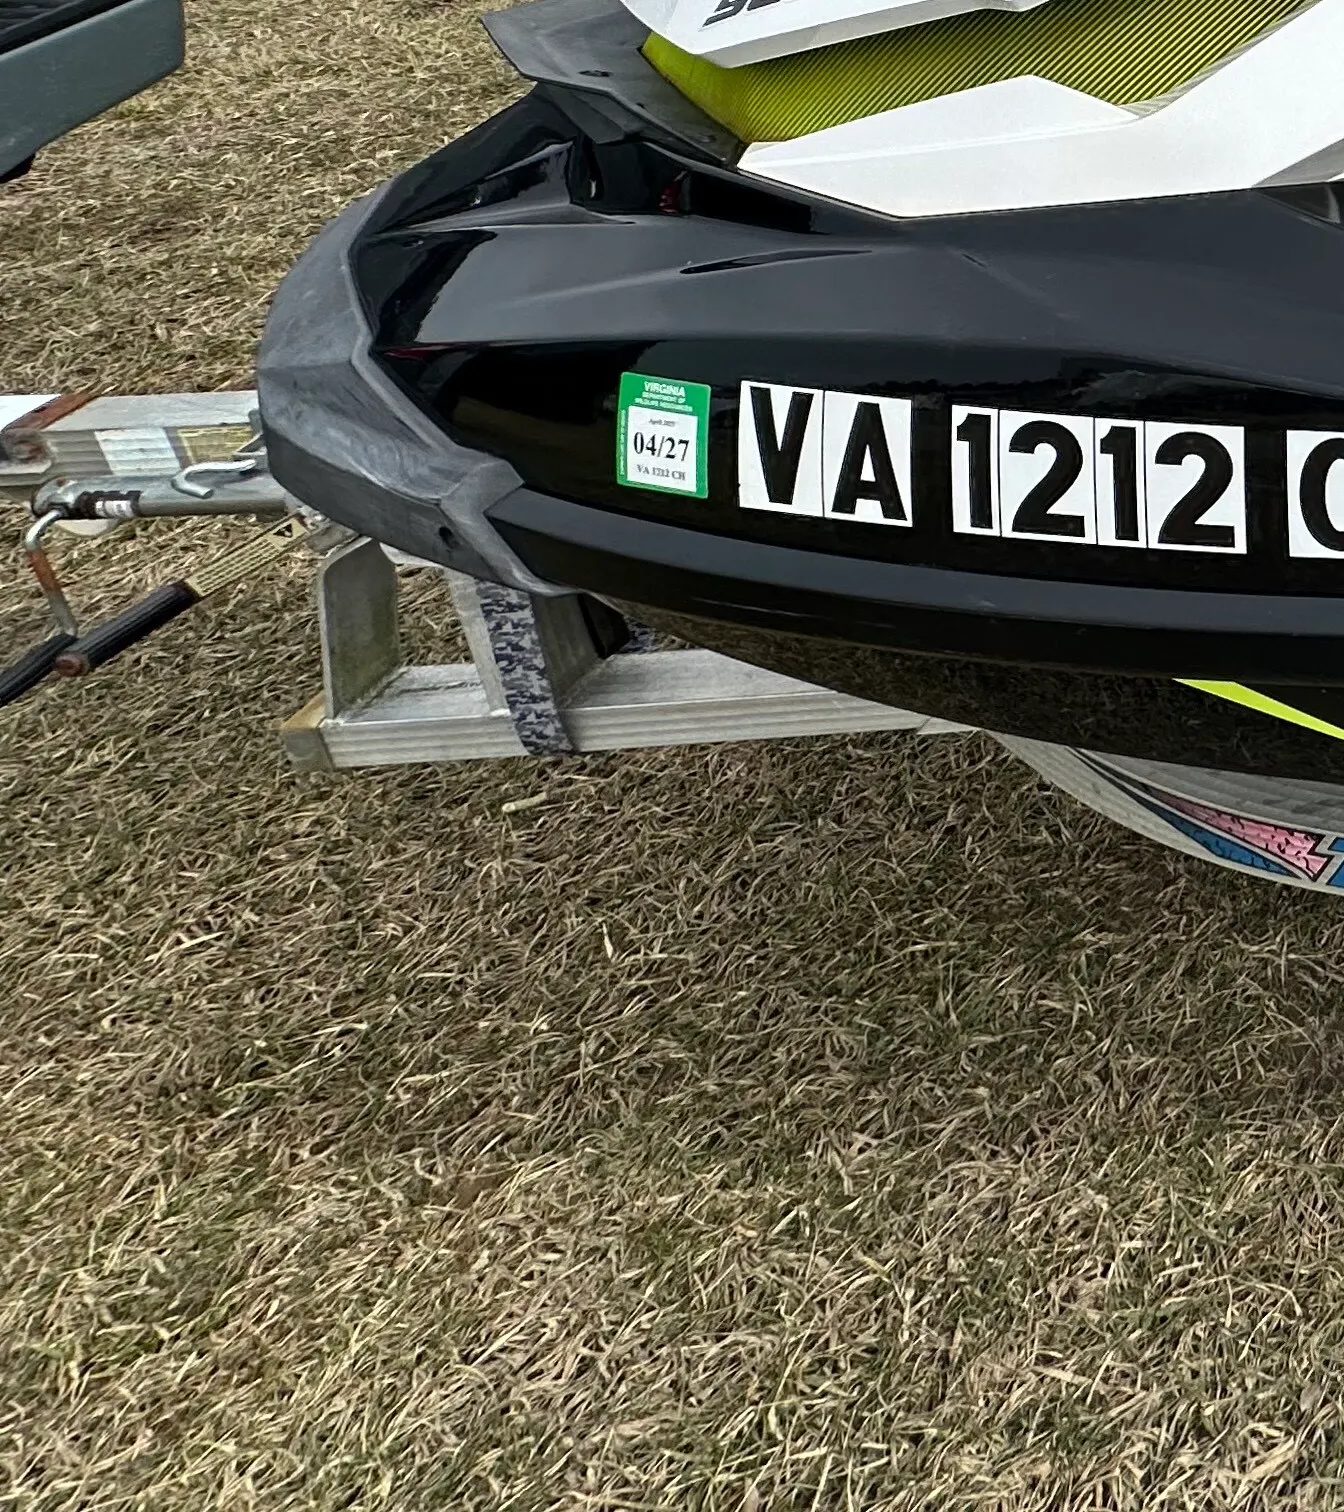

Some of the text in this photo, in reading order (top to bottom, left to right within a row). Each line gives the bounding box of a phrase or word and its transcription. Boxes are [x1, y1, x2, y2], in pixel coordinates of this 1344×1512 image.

[633, 431, 690, 462] 04/27
[637, 464, 650, 475] VA
[672, 470, 686, 481] CH
[749, 385, 908, 522] VA
[956, 411, 1236, 549] 1212
